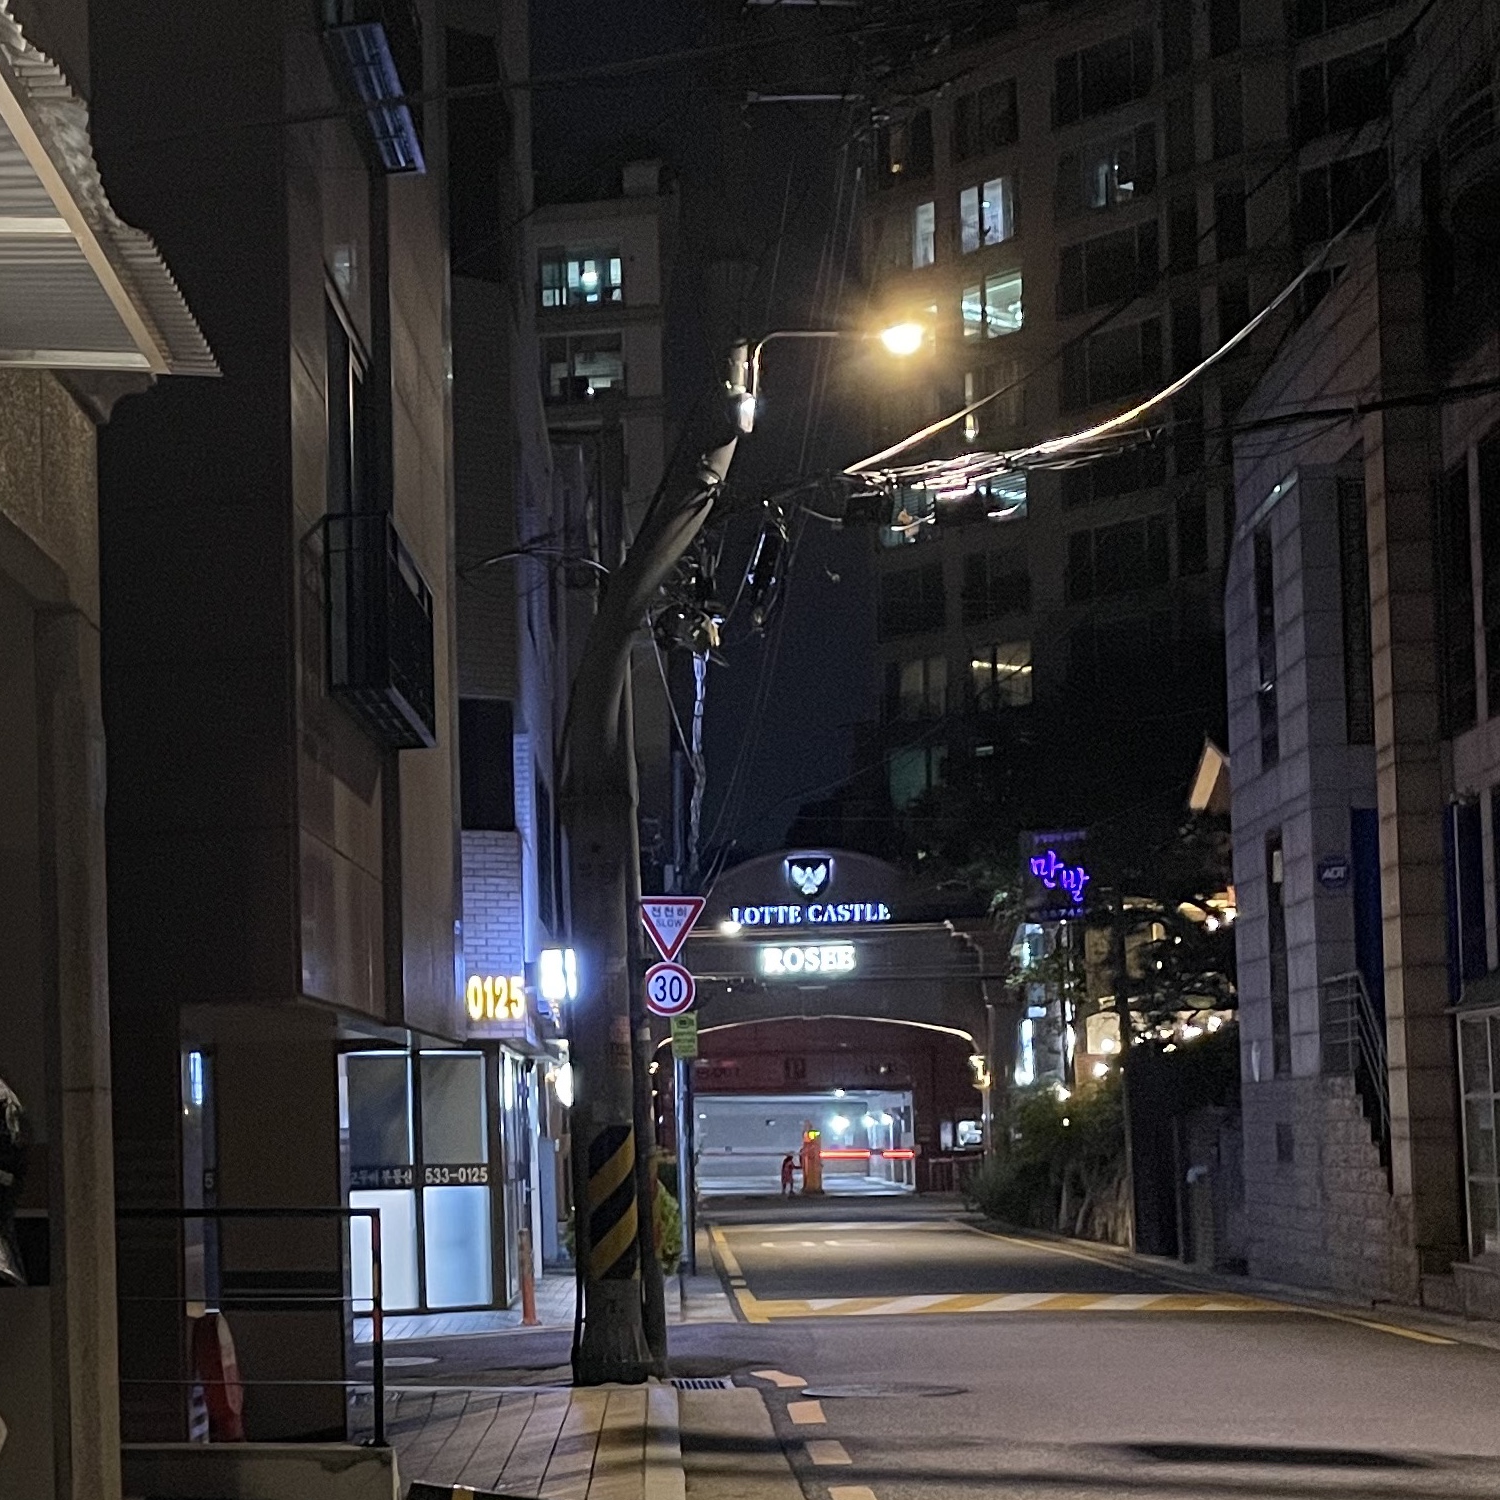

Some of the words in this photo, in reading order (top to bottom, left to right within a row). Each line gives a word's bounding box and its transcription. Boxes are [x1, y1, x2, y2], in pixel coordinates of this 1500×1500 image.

[1030, 850, 1090, 902] 만발
[1321, 866, 1347, 880] ADT
[651, 906, 687, 918] 천천히
[655, 918, 683, 928] SLOW
[731, 905, 802, 925] LOTTE
[807, 903, 891, 922] CASTLE
[467, 975, 525, 1020] 0125
[654, 975, 683, 1002] 30
